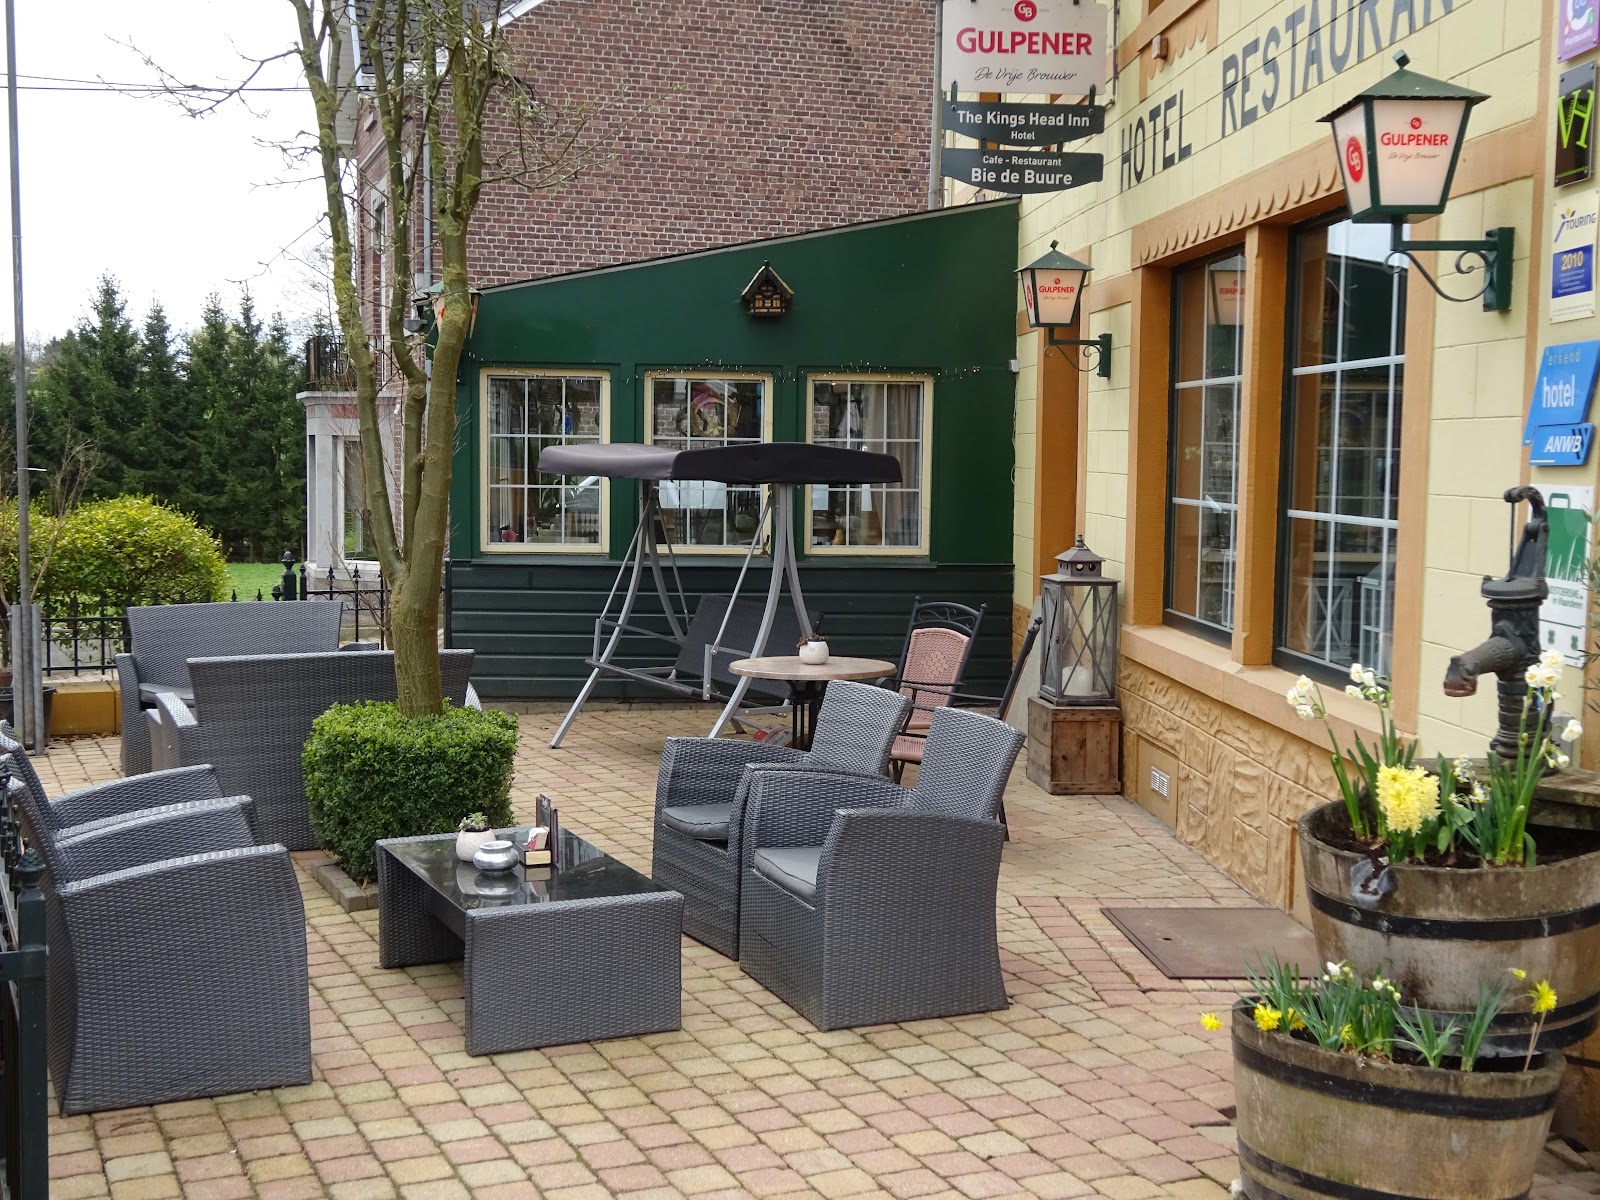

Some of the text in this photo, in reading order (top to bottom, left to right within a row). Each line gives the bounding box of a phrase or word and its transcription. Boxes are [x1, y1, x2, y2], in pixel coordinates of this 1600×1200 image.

[956, 27, 1093, 56] GULPENER
[974, 66, 1077, 86] De Vrije Brouwer
[957, 110, 1090, 127] The Kings Head Inn
[1011, 131, 1035, 140] Hotel
[1120, 89, 1193, 194] HOTEL
[1380, 132, 1449, 146] GULPENER
[982, 155, 1003, 165] Cafe
[1011, 156, 1062, 166] Restaurant
[971, 168, 1073, 185] Bie de Buure
[1566, 213, 1596, 230] TOURING
[1561, 250, 1584, 271] 2010
[1038, 285, 1075, 294] GULPENER
[1548, 351, 1580, 366] erkend
[1543, 374, 1575, 408] hotel
[1543, 435, 1583, 453] ANWB
